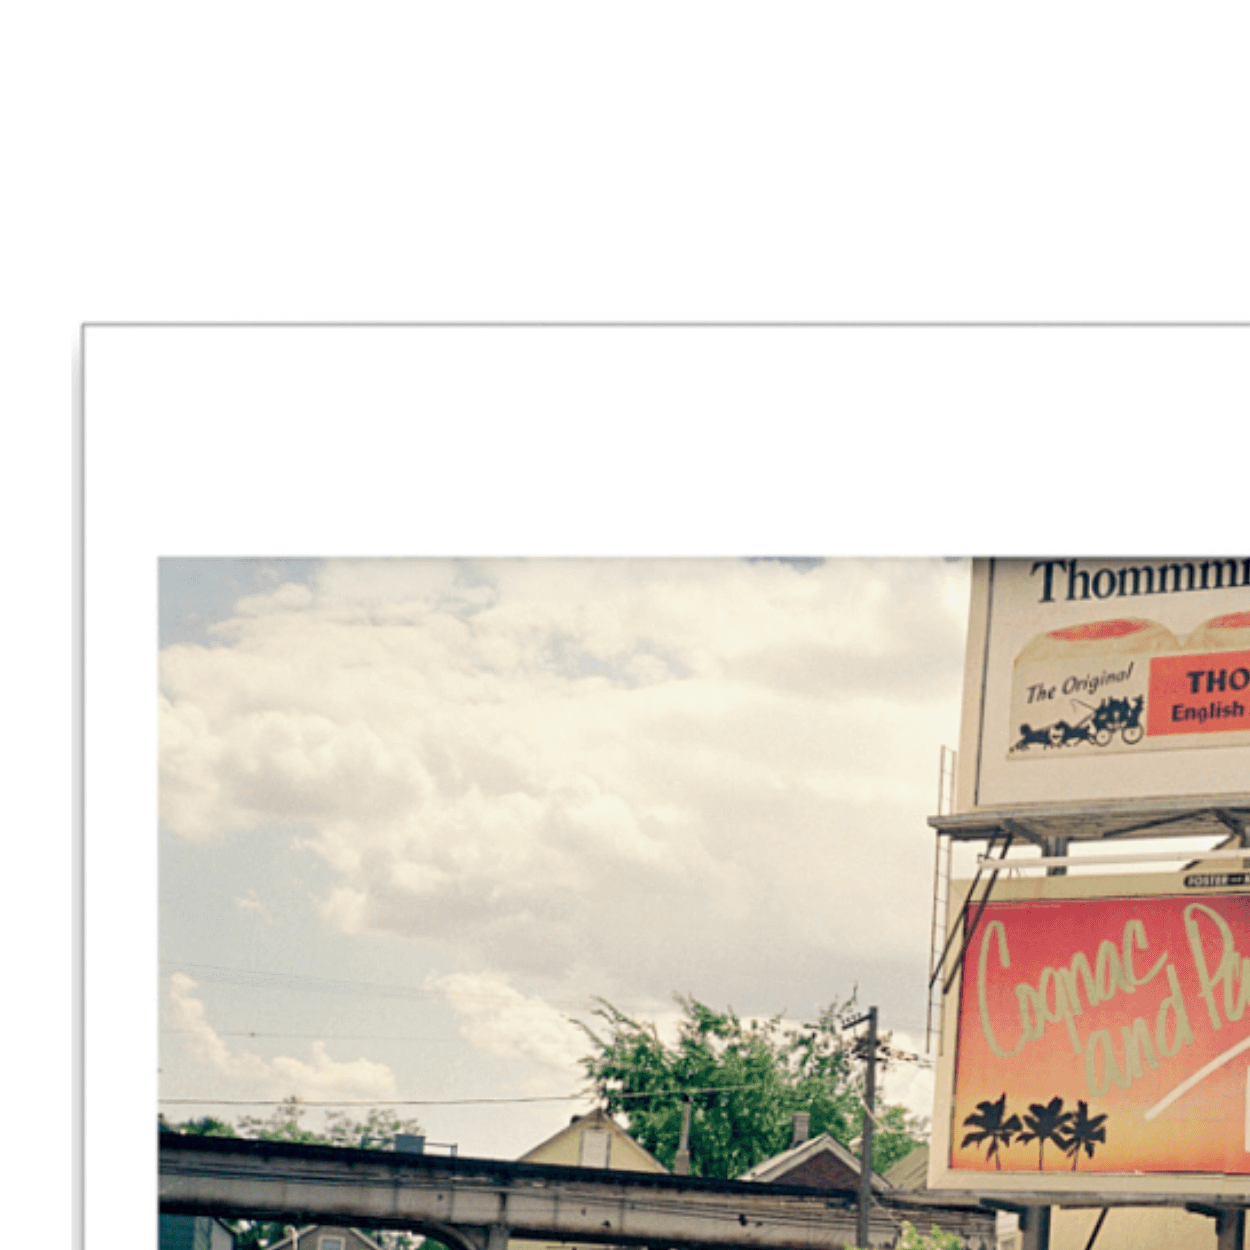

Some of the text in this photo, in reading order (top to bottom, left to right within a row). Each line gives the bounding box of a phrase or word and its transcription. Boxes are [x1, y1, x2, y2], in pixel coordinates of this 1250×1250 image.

[1025, 660, 1135, 705] The Original
[1170, 700, 1245, 724] English
[977, 920, 1168, 1058] Cognac
[1084, 964, 1195, 1098] and
